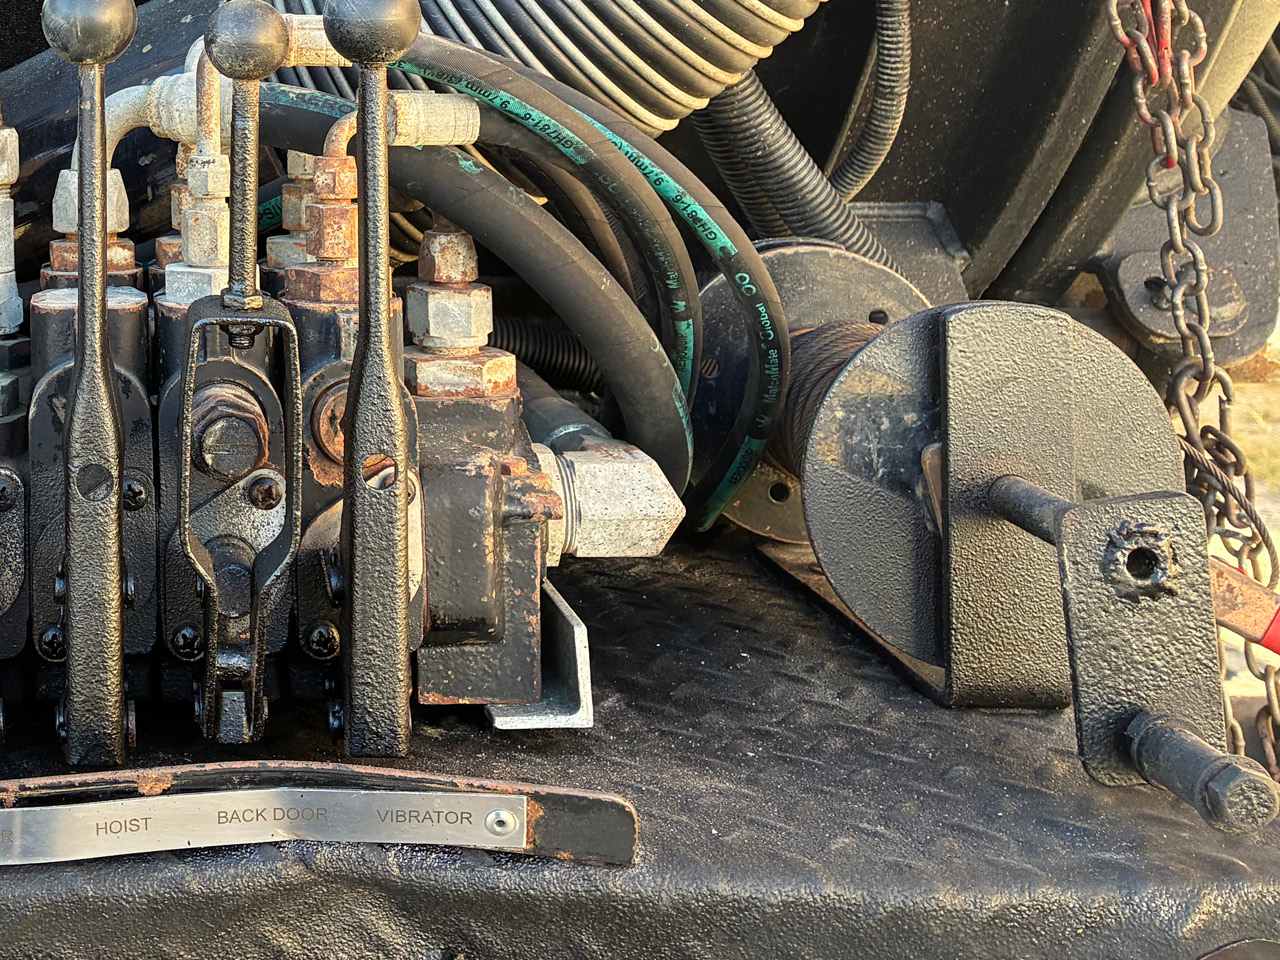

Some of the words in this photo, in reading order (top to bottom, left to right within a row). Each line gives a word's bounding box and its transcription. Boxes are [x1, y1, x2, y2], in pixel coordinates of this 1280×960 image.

[464, 82, 511, 110] 9.7mm
[520, 112, 577, 150] GH781-6
[95, 816, 153, 837] HOIST
[217, 808, 268, 825] BACK
[273, 806, 329, 823] DOOR
[377, 808, 474, 826] VIBRATOR
